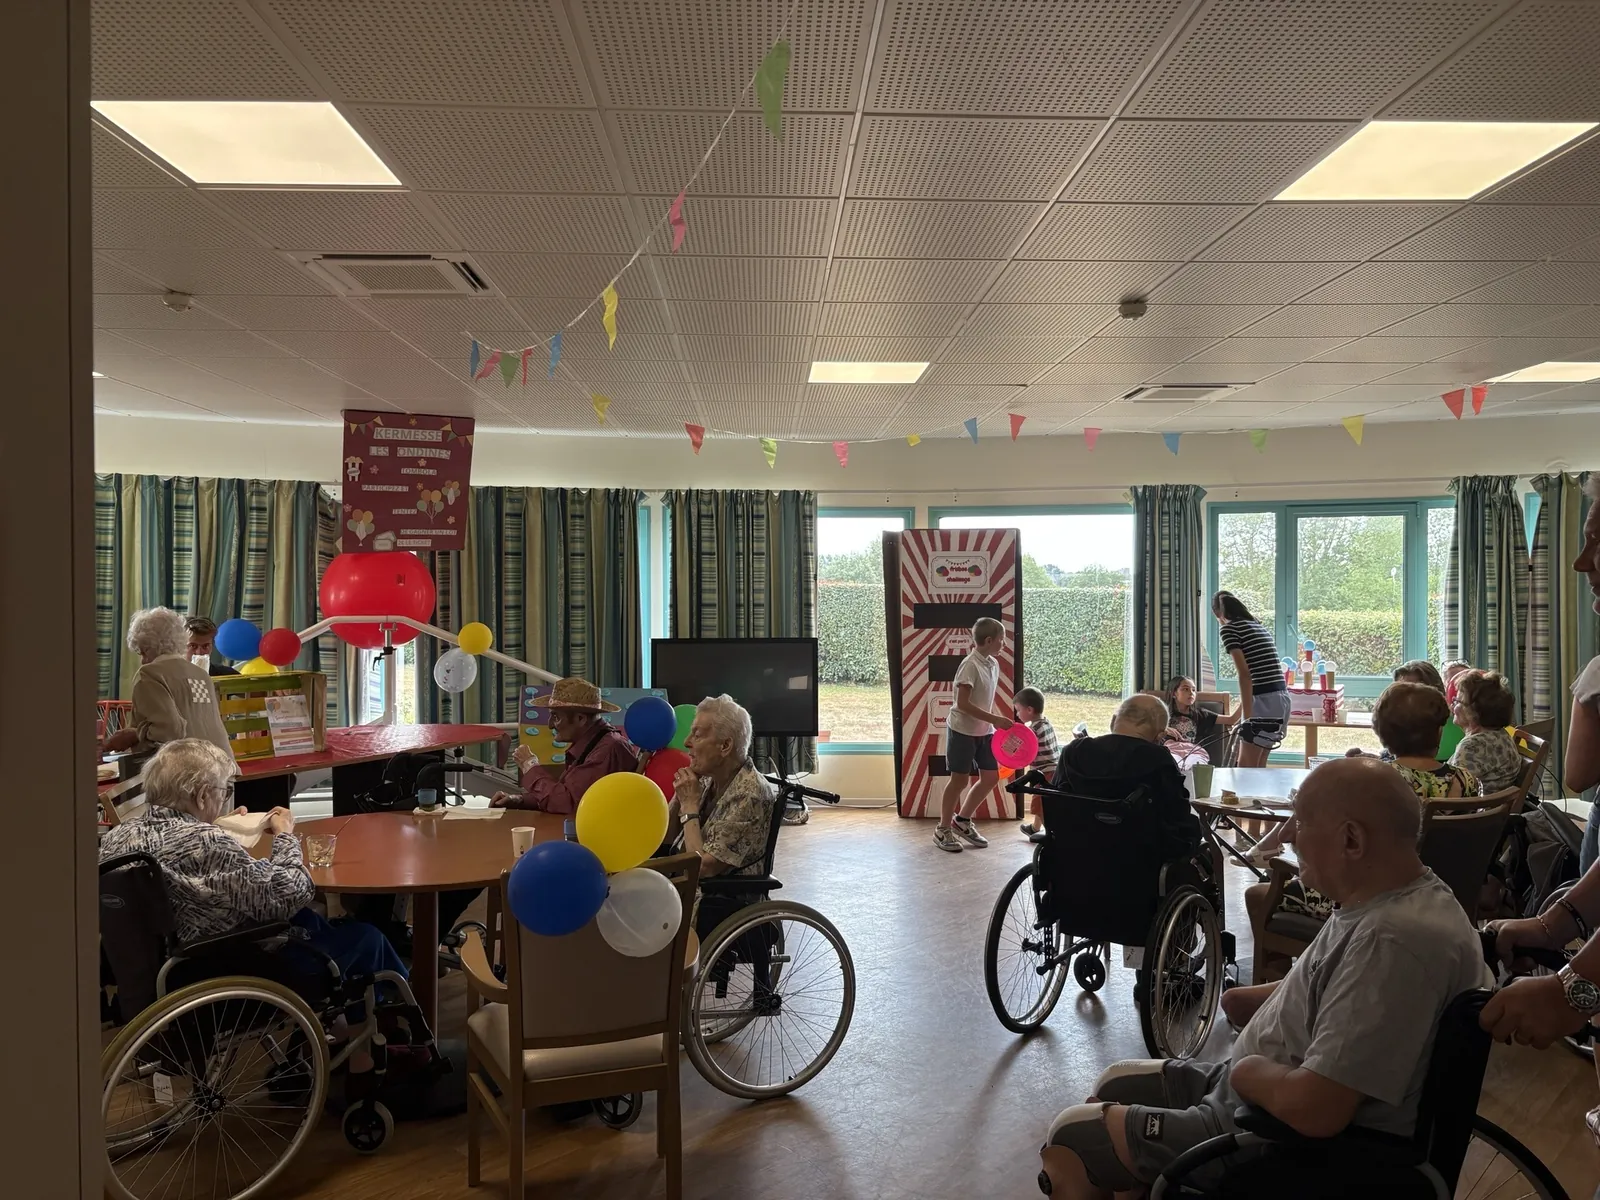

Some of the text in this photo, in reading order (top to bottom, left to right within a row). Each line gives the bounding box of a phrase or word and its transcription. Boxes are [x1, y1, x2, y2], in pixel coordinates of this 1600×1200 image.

[375, 428, 442, 440] KERMESSE
[370, 446, 451, 459] LES ONDINES
